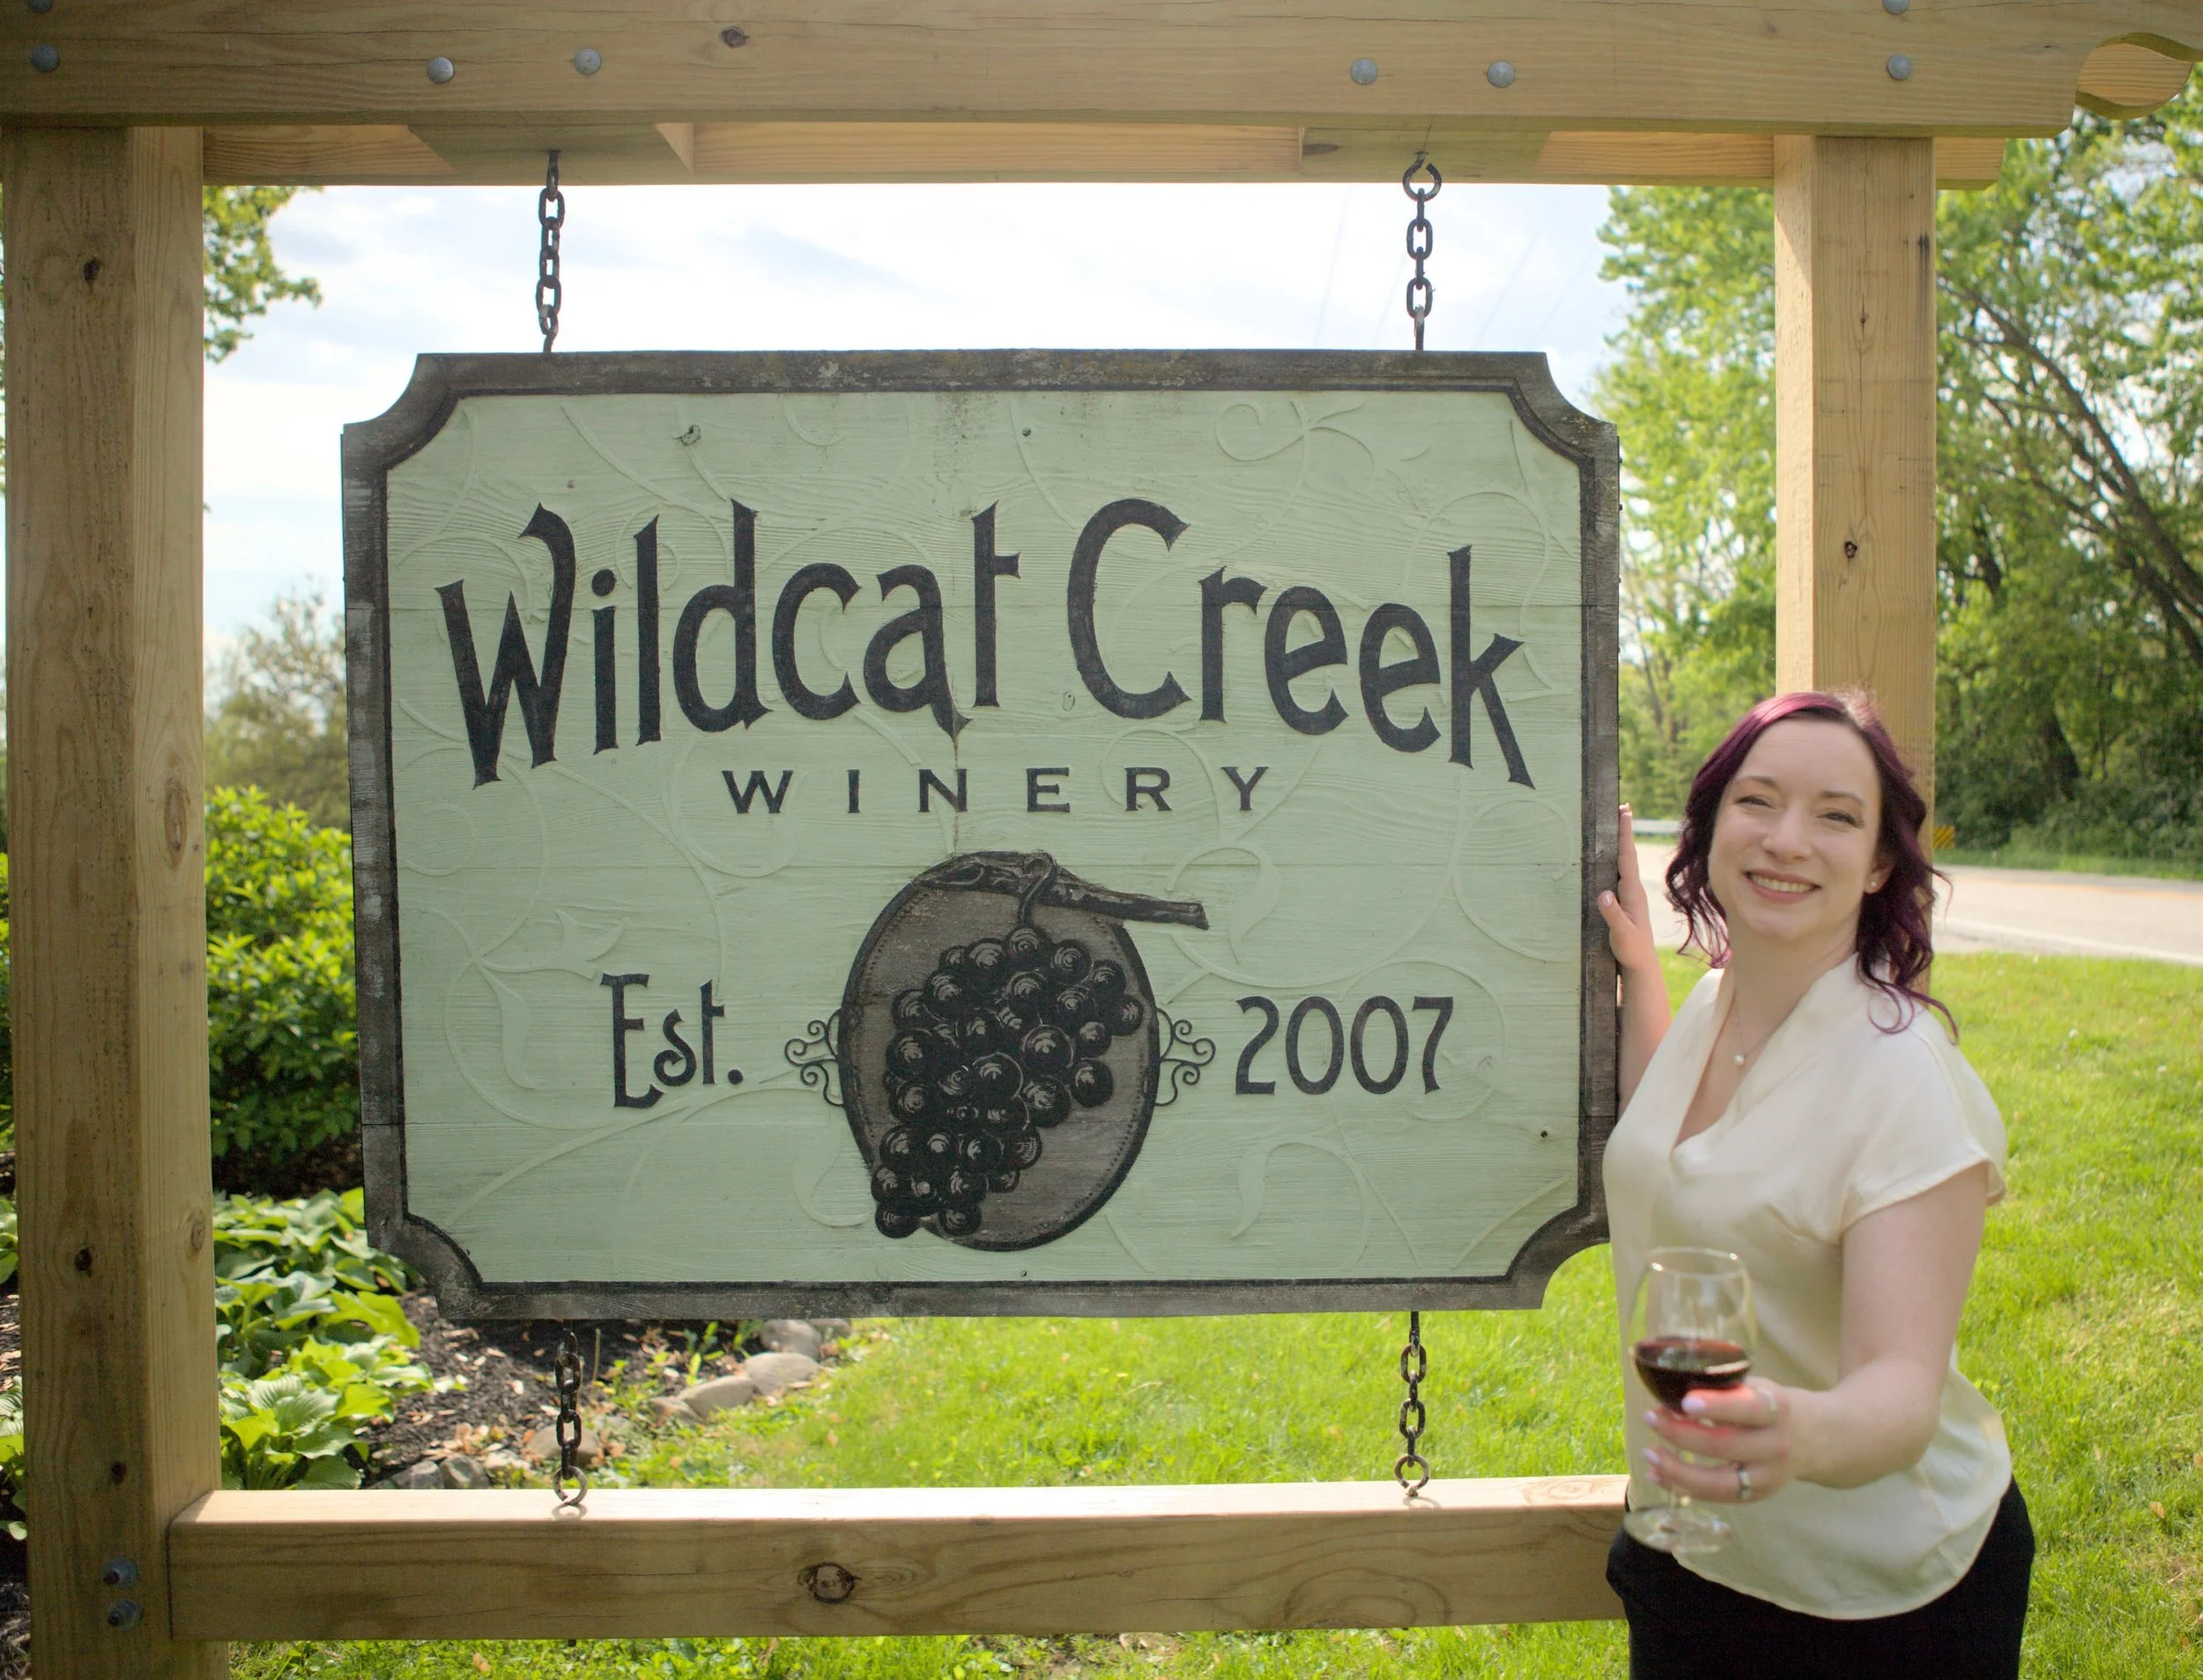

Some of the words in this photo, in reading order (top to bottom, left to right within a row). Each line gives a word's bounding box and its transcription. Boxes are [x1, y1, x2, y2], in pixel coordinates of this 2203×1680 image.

[434, 498, 1020, 788] Wildcat
[1066, 498, 1536, 789] Creek
[722, 766, 1269, 815] WINERY
[600, 973, 744, 1109] Est.
[1235, 995, 1454, 1096] 2007
